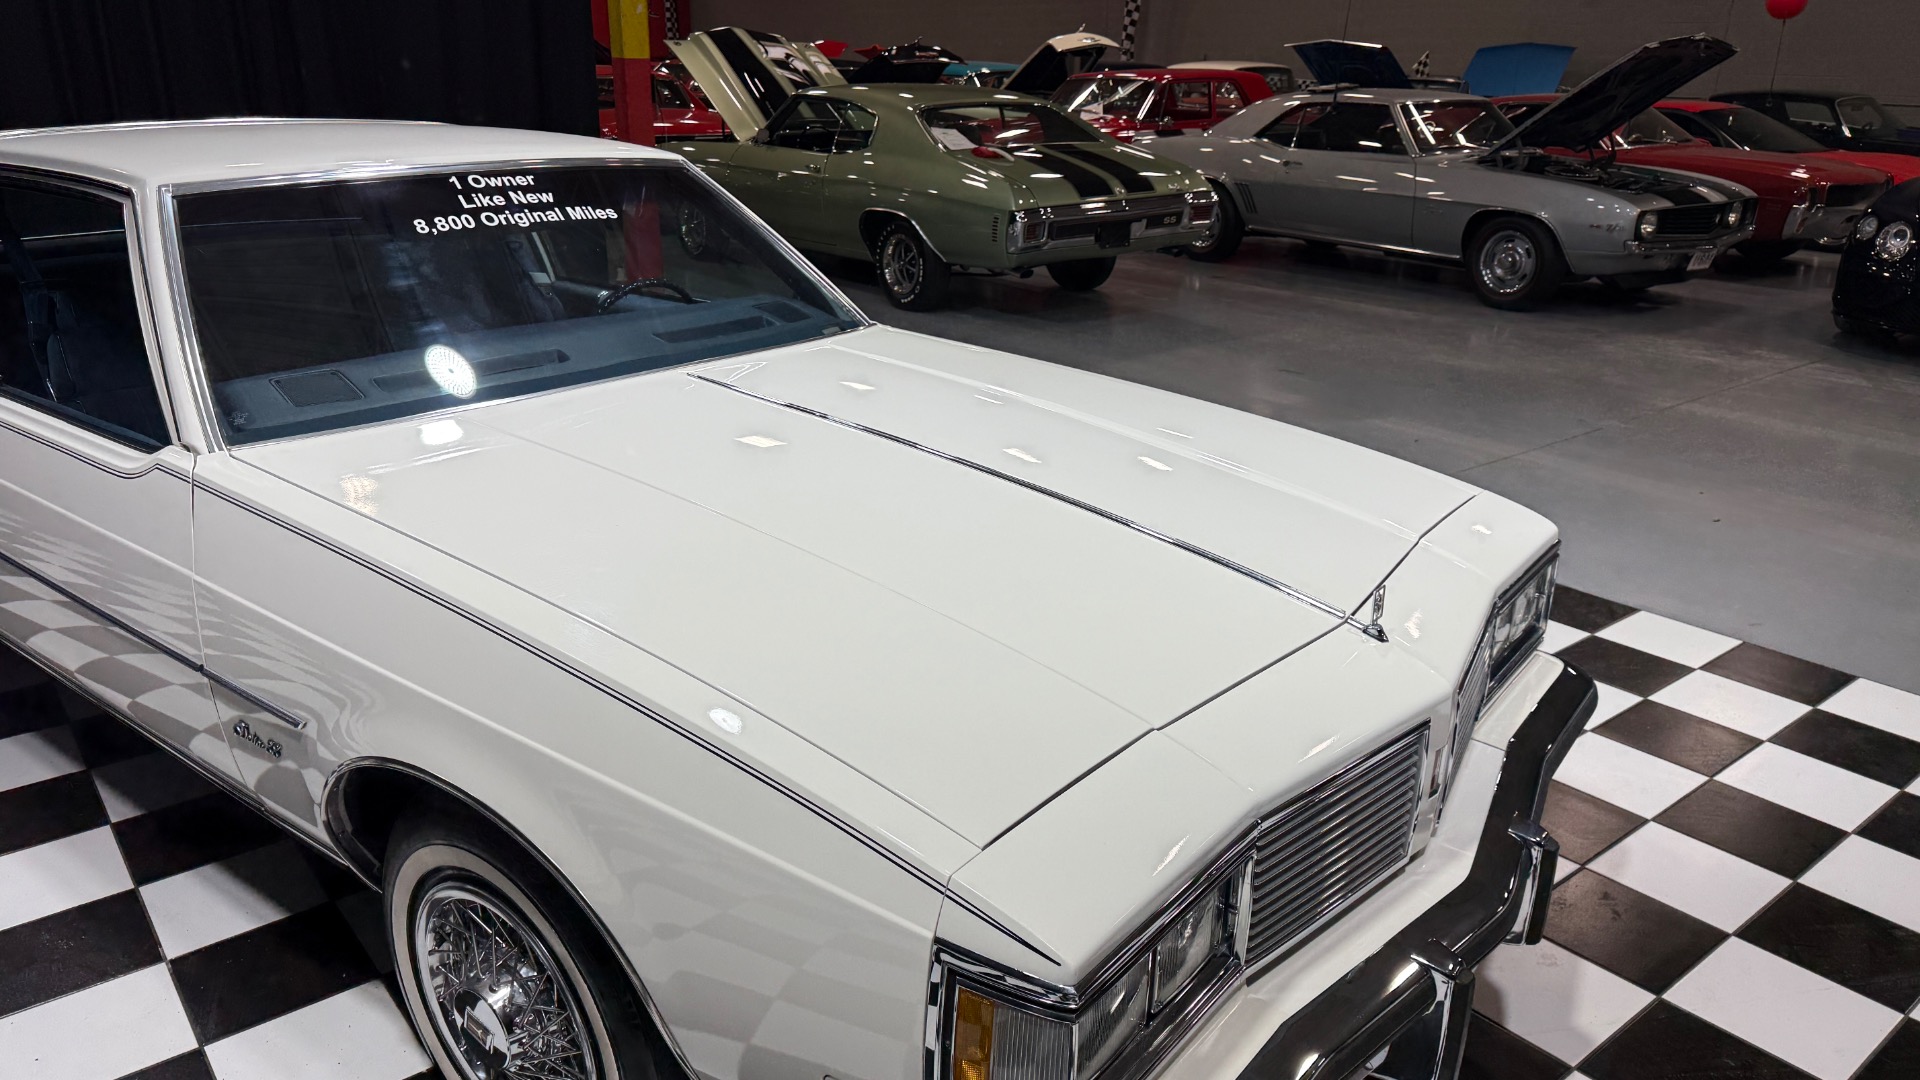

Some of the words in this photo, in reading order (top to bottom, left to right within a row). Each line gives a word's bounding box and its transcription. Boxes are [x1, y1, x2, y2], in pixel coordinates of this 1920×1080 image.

[448, 175, 463, 190] 1
[467, 173, 535, 189] Owner
[458, 193, 507, 209] Like
[508, 190, 555, 205] New
[413, 213, 476, 236] 8,800
[480, 207, 564, 228] Original
[568, 205, 619, 220] Miles
[1163, 215, 1177, 224] SS
